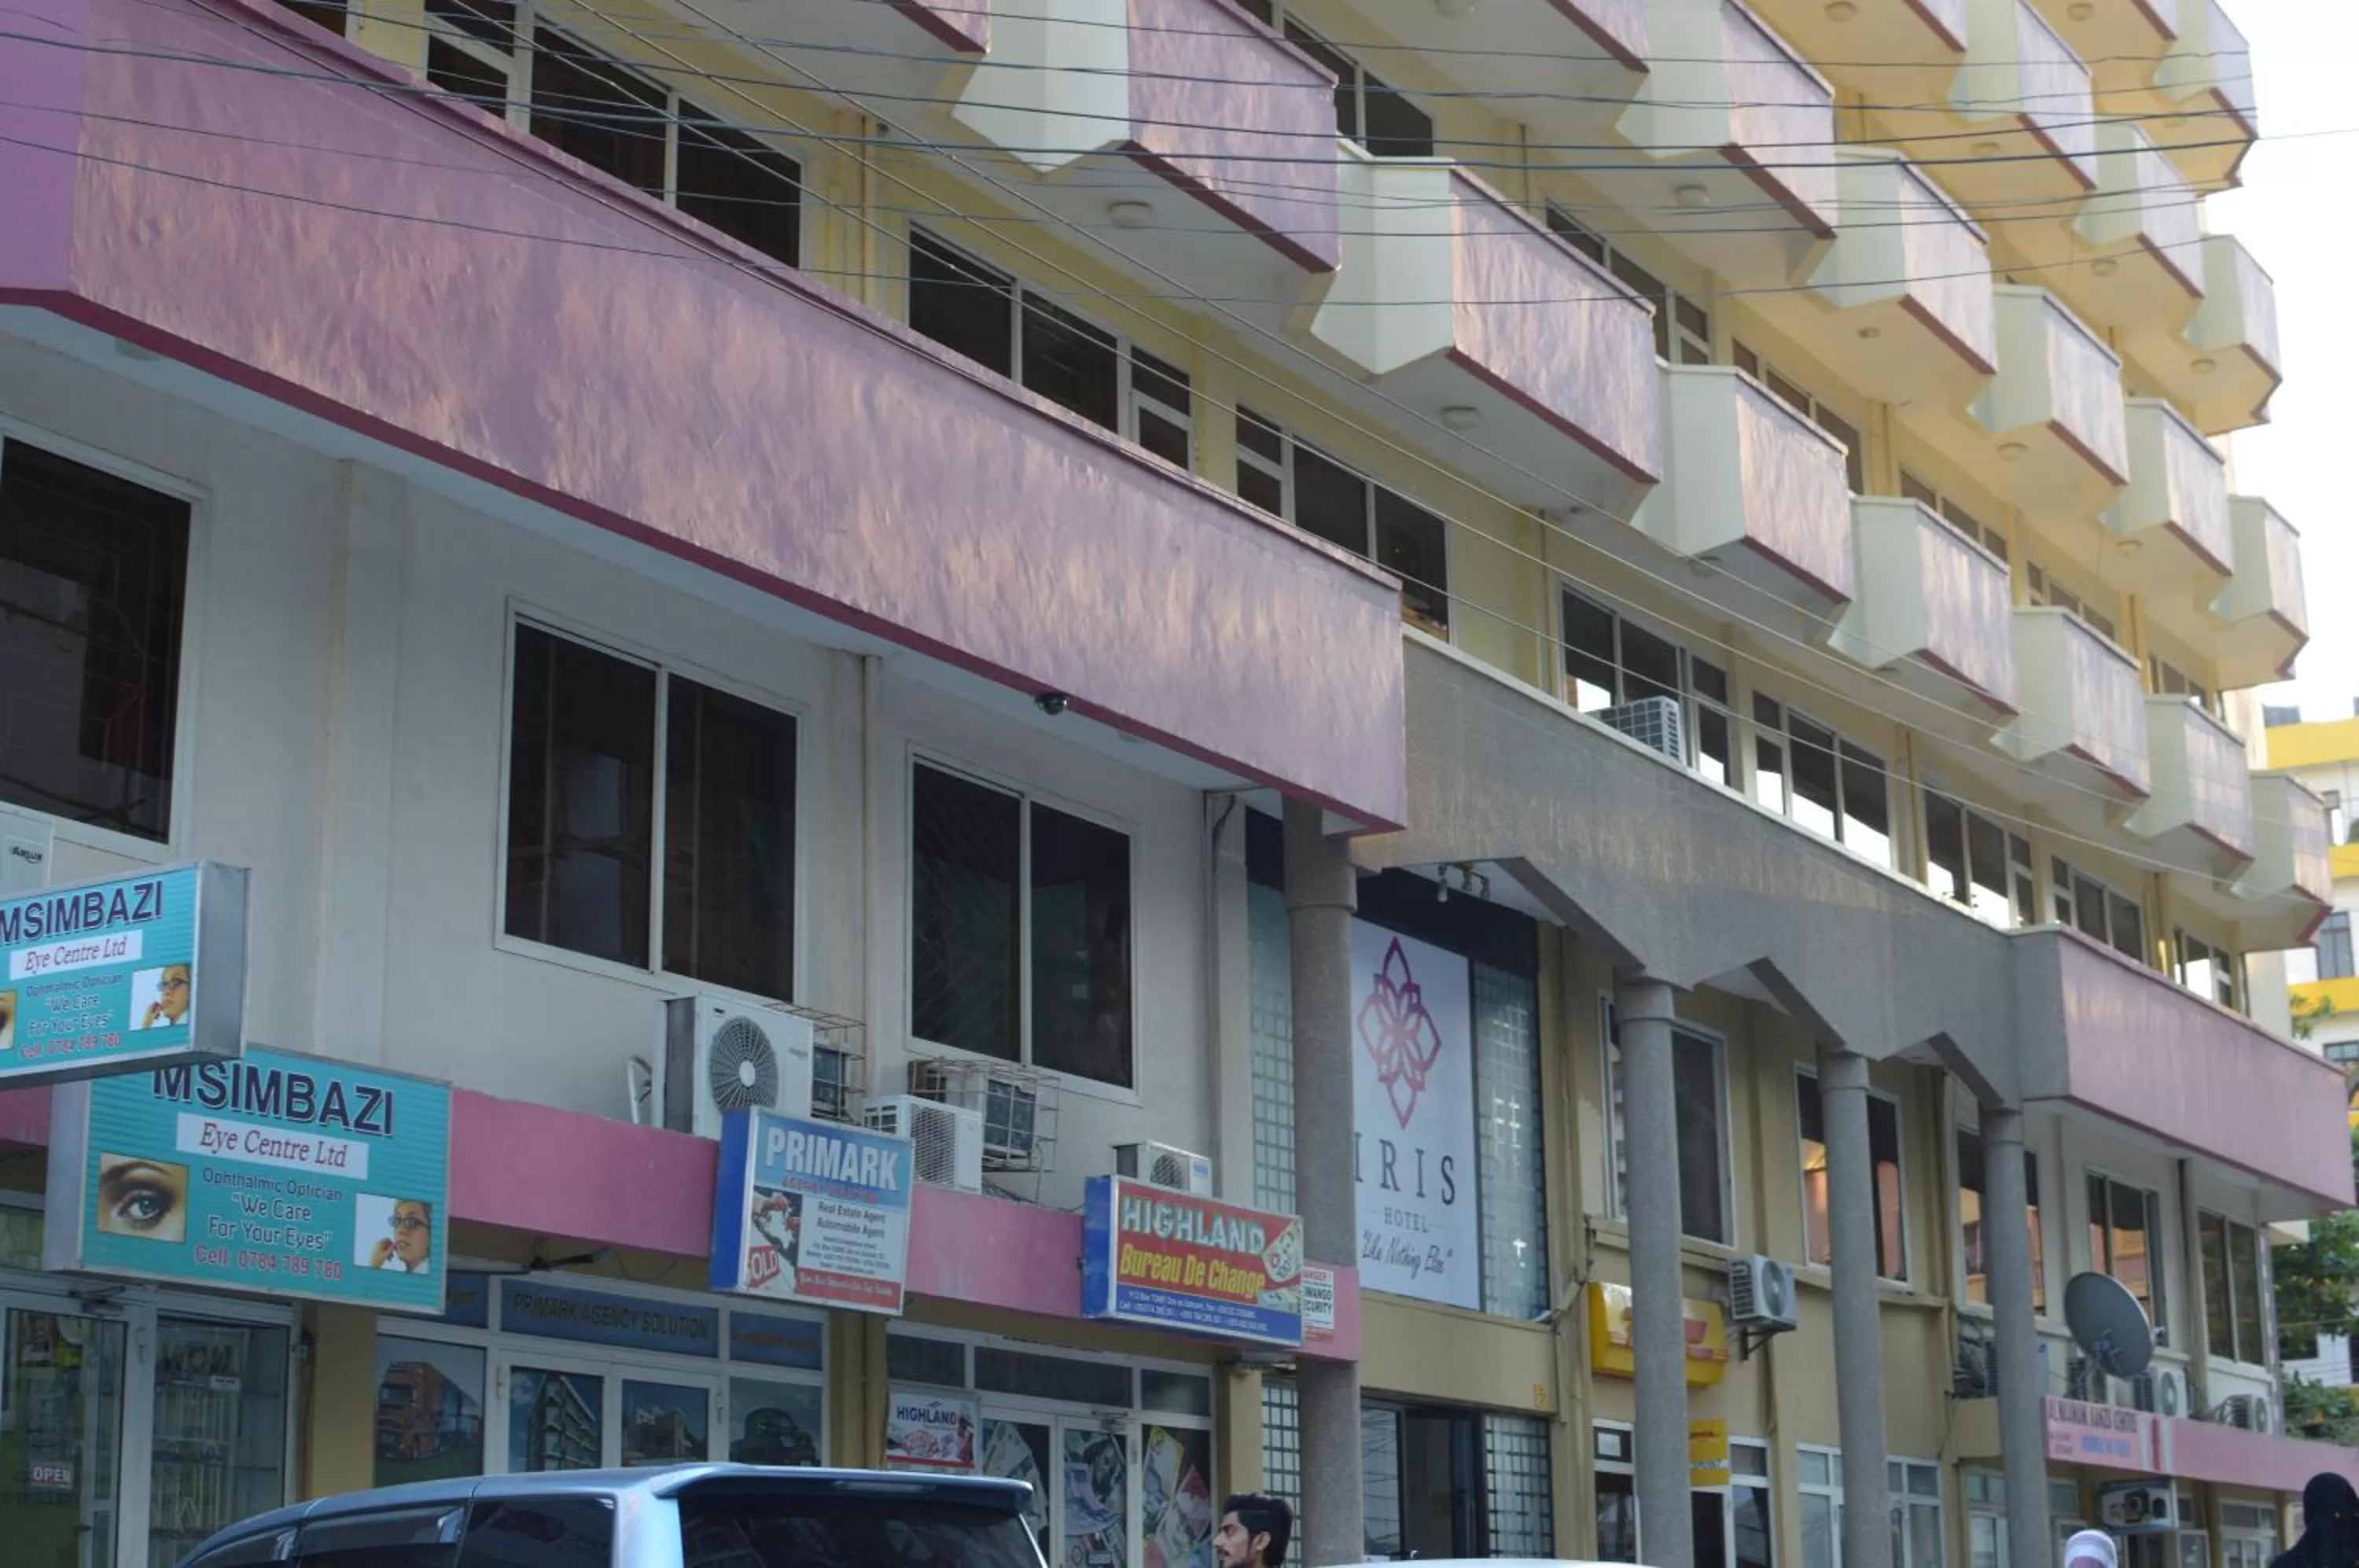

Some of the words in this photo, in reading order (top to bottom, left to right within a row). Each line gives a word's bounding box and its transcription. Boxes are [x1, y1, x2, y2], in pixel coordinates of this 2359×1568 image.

[0, 880, 163, 944] MSIMBAZI
[25, 950, 50, 974] Eye
[53, 945, 100, 966] Centre
[103, 936, 128, 959] Ltd
[26, 981, 80, 996] Ophthalmic
[72, 993, 101, 1010] Care
[29, 1021, 49, 1036] For
[50, 1016, 79, 1033] Your
[153, 1060, 393, 1136] MSIMBAZI
[200, 1122, 237, 1153] Eye
[244, 1130, 310, 1161] Centre
[315, 1139, 348, 1168] Ltd
[765, 1127, 900, 1191] PRIMARK
[203, 1167, 282, 1195] Ophthalmic
[286, 1179, 343, 1202] Optician
[1354, 1132, 1456, 1205] IRIS
[271, 1202, 311, 1222] Care
[818, 1201, 837, 1214] Real
[1121, 1194, 1266, 1256] HIGHLAND
[1384, 1207, 1430, 1234] HOTEL
[208, 1216, 238, 1238] For
[242, 1220, 282, 1243] Your
[238, 1250, 276, 1271] 0784
[282, 1256, 310, 1275] 789
[315, 1260, 343, 1280] 780
[1120, 1242, 1183, 1284] Bureau
[1184, 1253, 1205, 1288] De
[1208, 1260, 1265, 1298] Change
[513, 1292, 578, 1322] PRIMARK
[580, 1301, 641, 1331] AGENCY
[642, 1310, 708, 1338] SOLUTION
[896, 1405, 959, 1425] HIGHLAND
